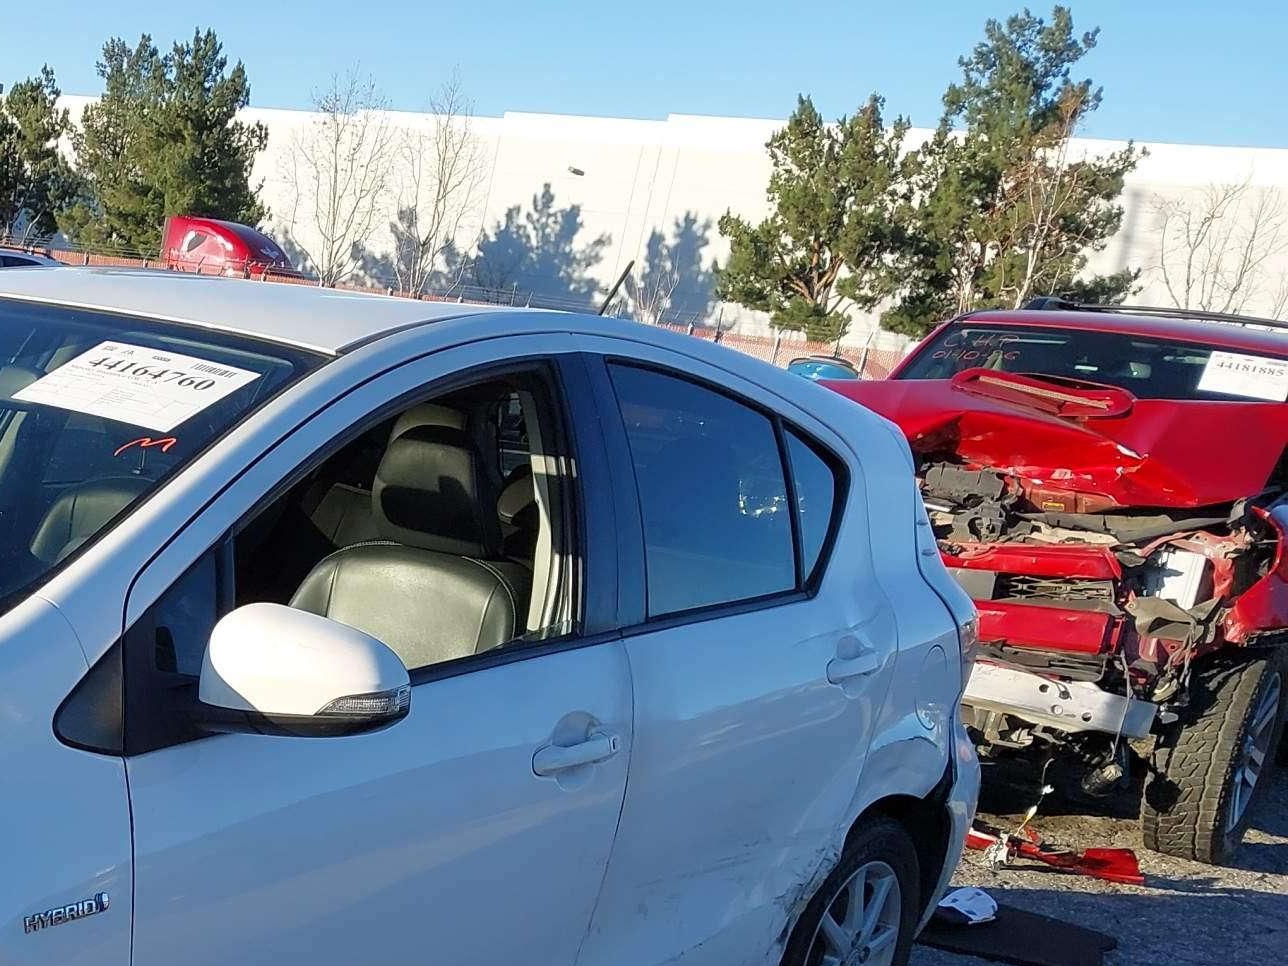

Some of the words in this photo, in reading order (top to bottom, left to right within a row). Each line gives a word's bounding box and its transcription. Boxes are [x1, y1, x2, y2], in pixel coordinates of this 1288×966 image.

[89, 356, 216, 391] 44164760
[1217, 361, 1285, 377] 44181885
[23, 899, 97, 934] HYBRID
